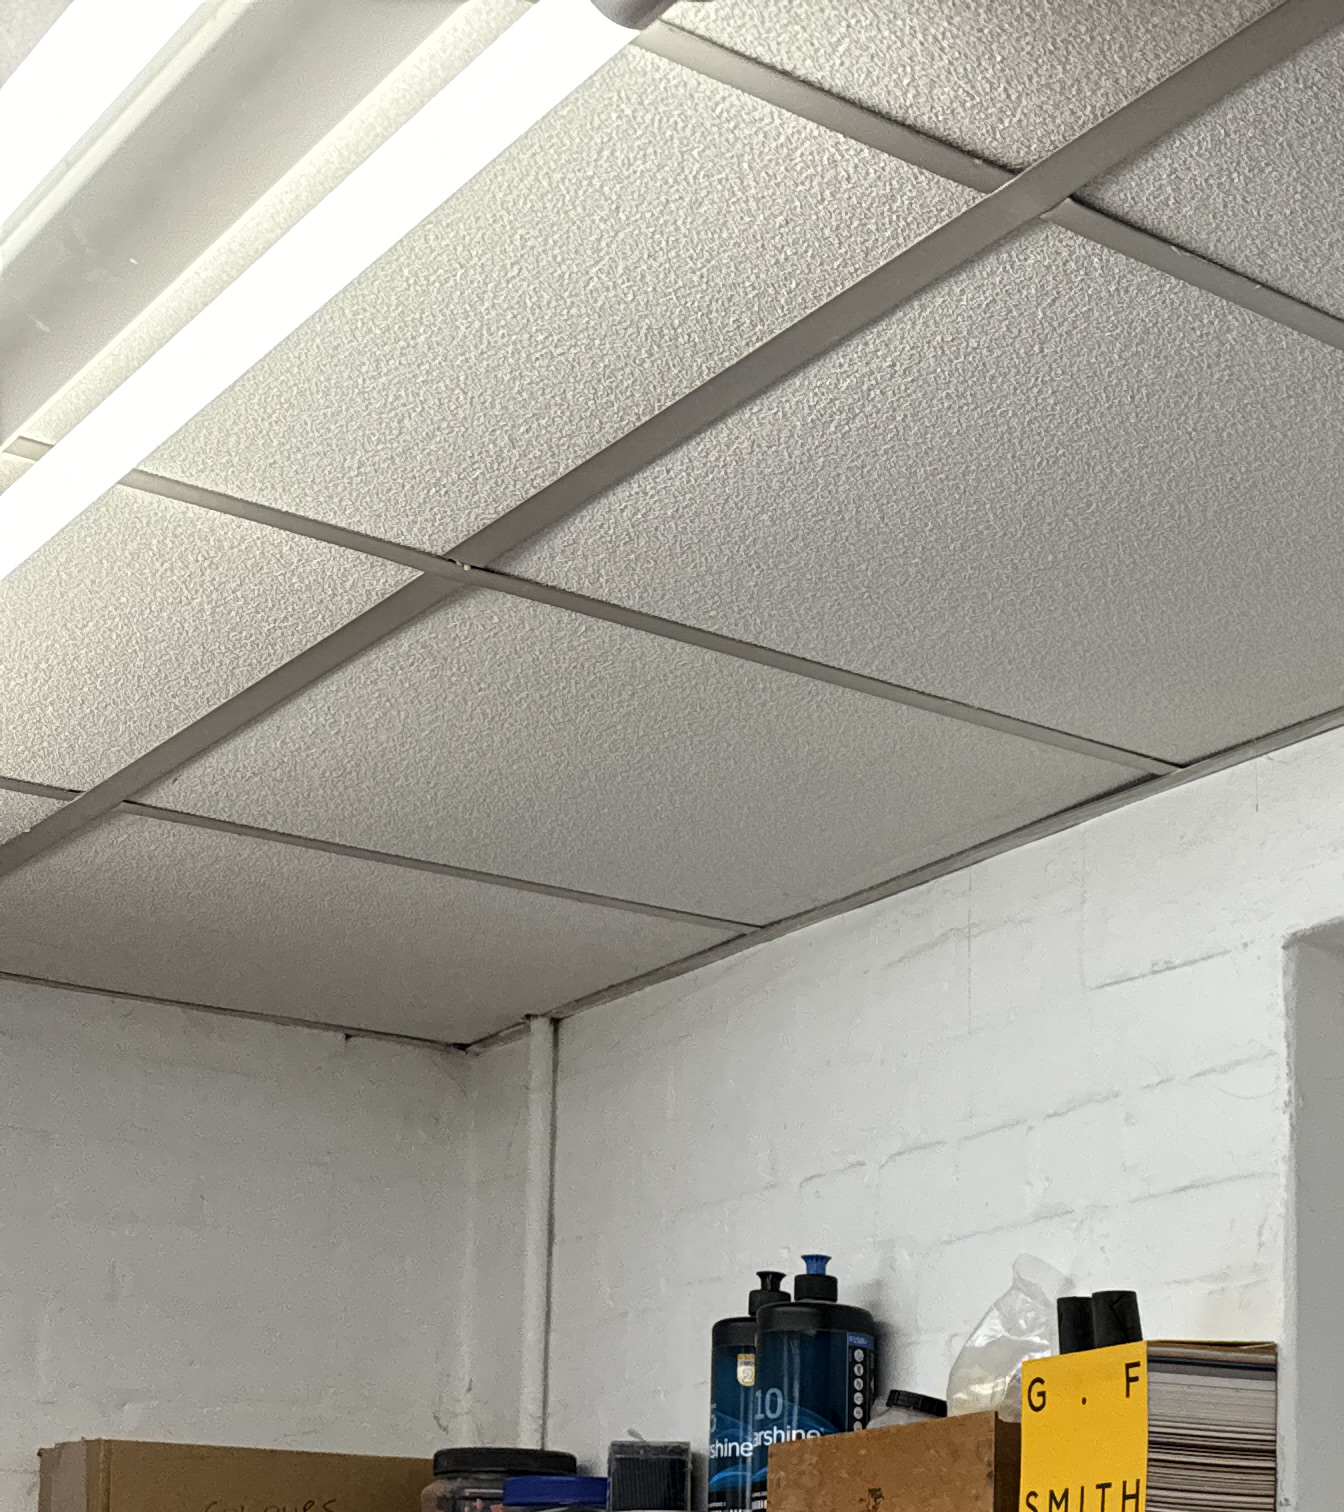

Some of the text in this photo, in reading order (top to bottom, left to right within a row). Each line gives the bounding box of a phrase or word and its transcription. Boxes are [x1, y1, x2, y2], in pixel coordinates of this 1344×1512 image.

[754, 1387, 784, 1420] 10
[1027, 1376, 1047, 1413] G
[1124, 1360, 1142, 1399] F
